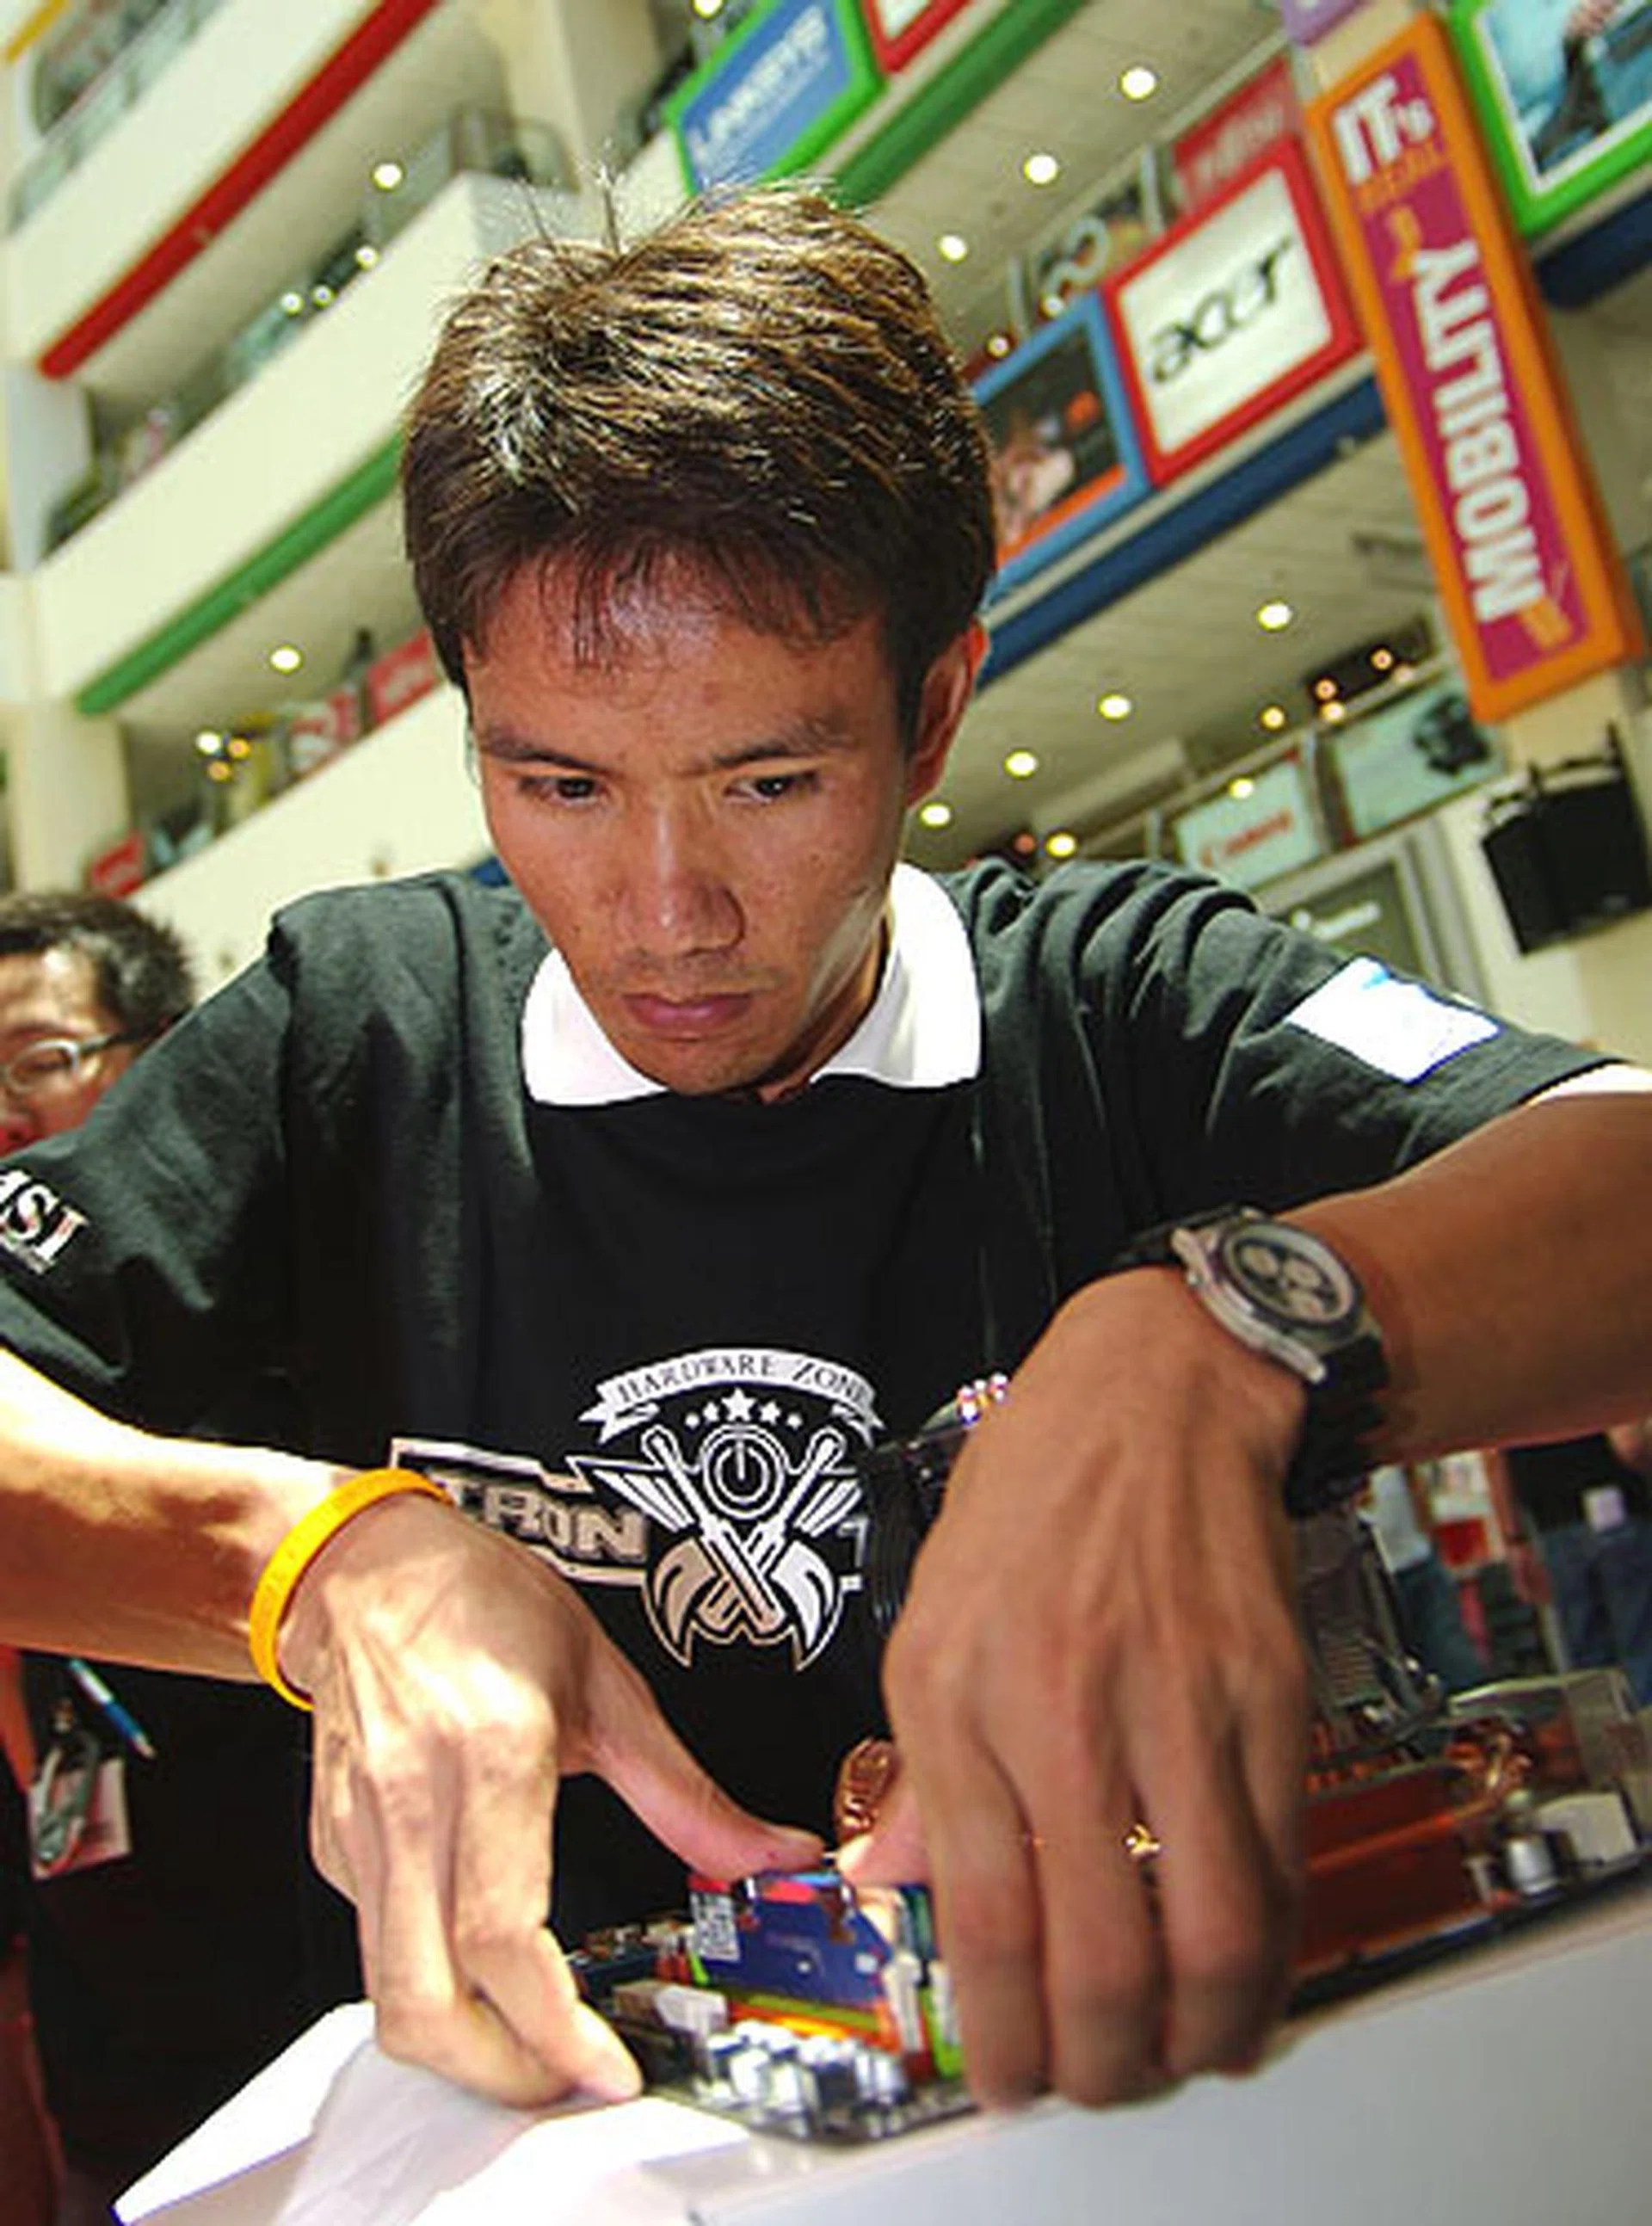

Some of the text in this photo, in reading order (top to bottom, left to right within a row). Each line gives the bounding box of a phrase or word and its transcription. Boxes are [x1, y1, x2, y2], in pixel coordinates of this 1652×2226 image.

[1150, 234, 1294, 382] acer
[1412, 237, 1547, 622] MOBILITY
[615, 1353, 776, 1404] HARDWARE
